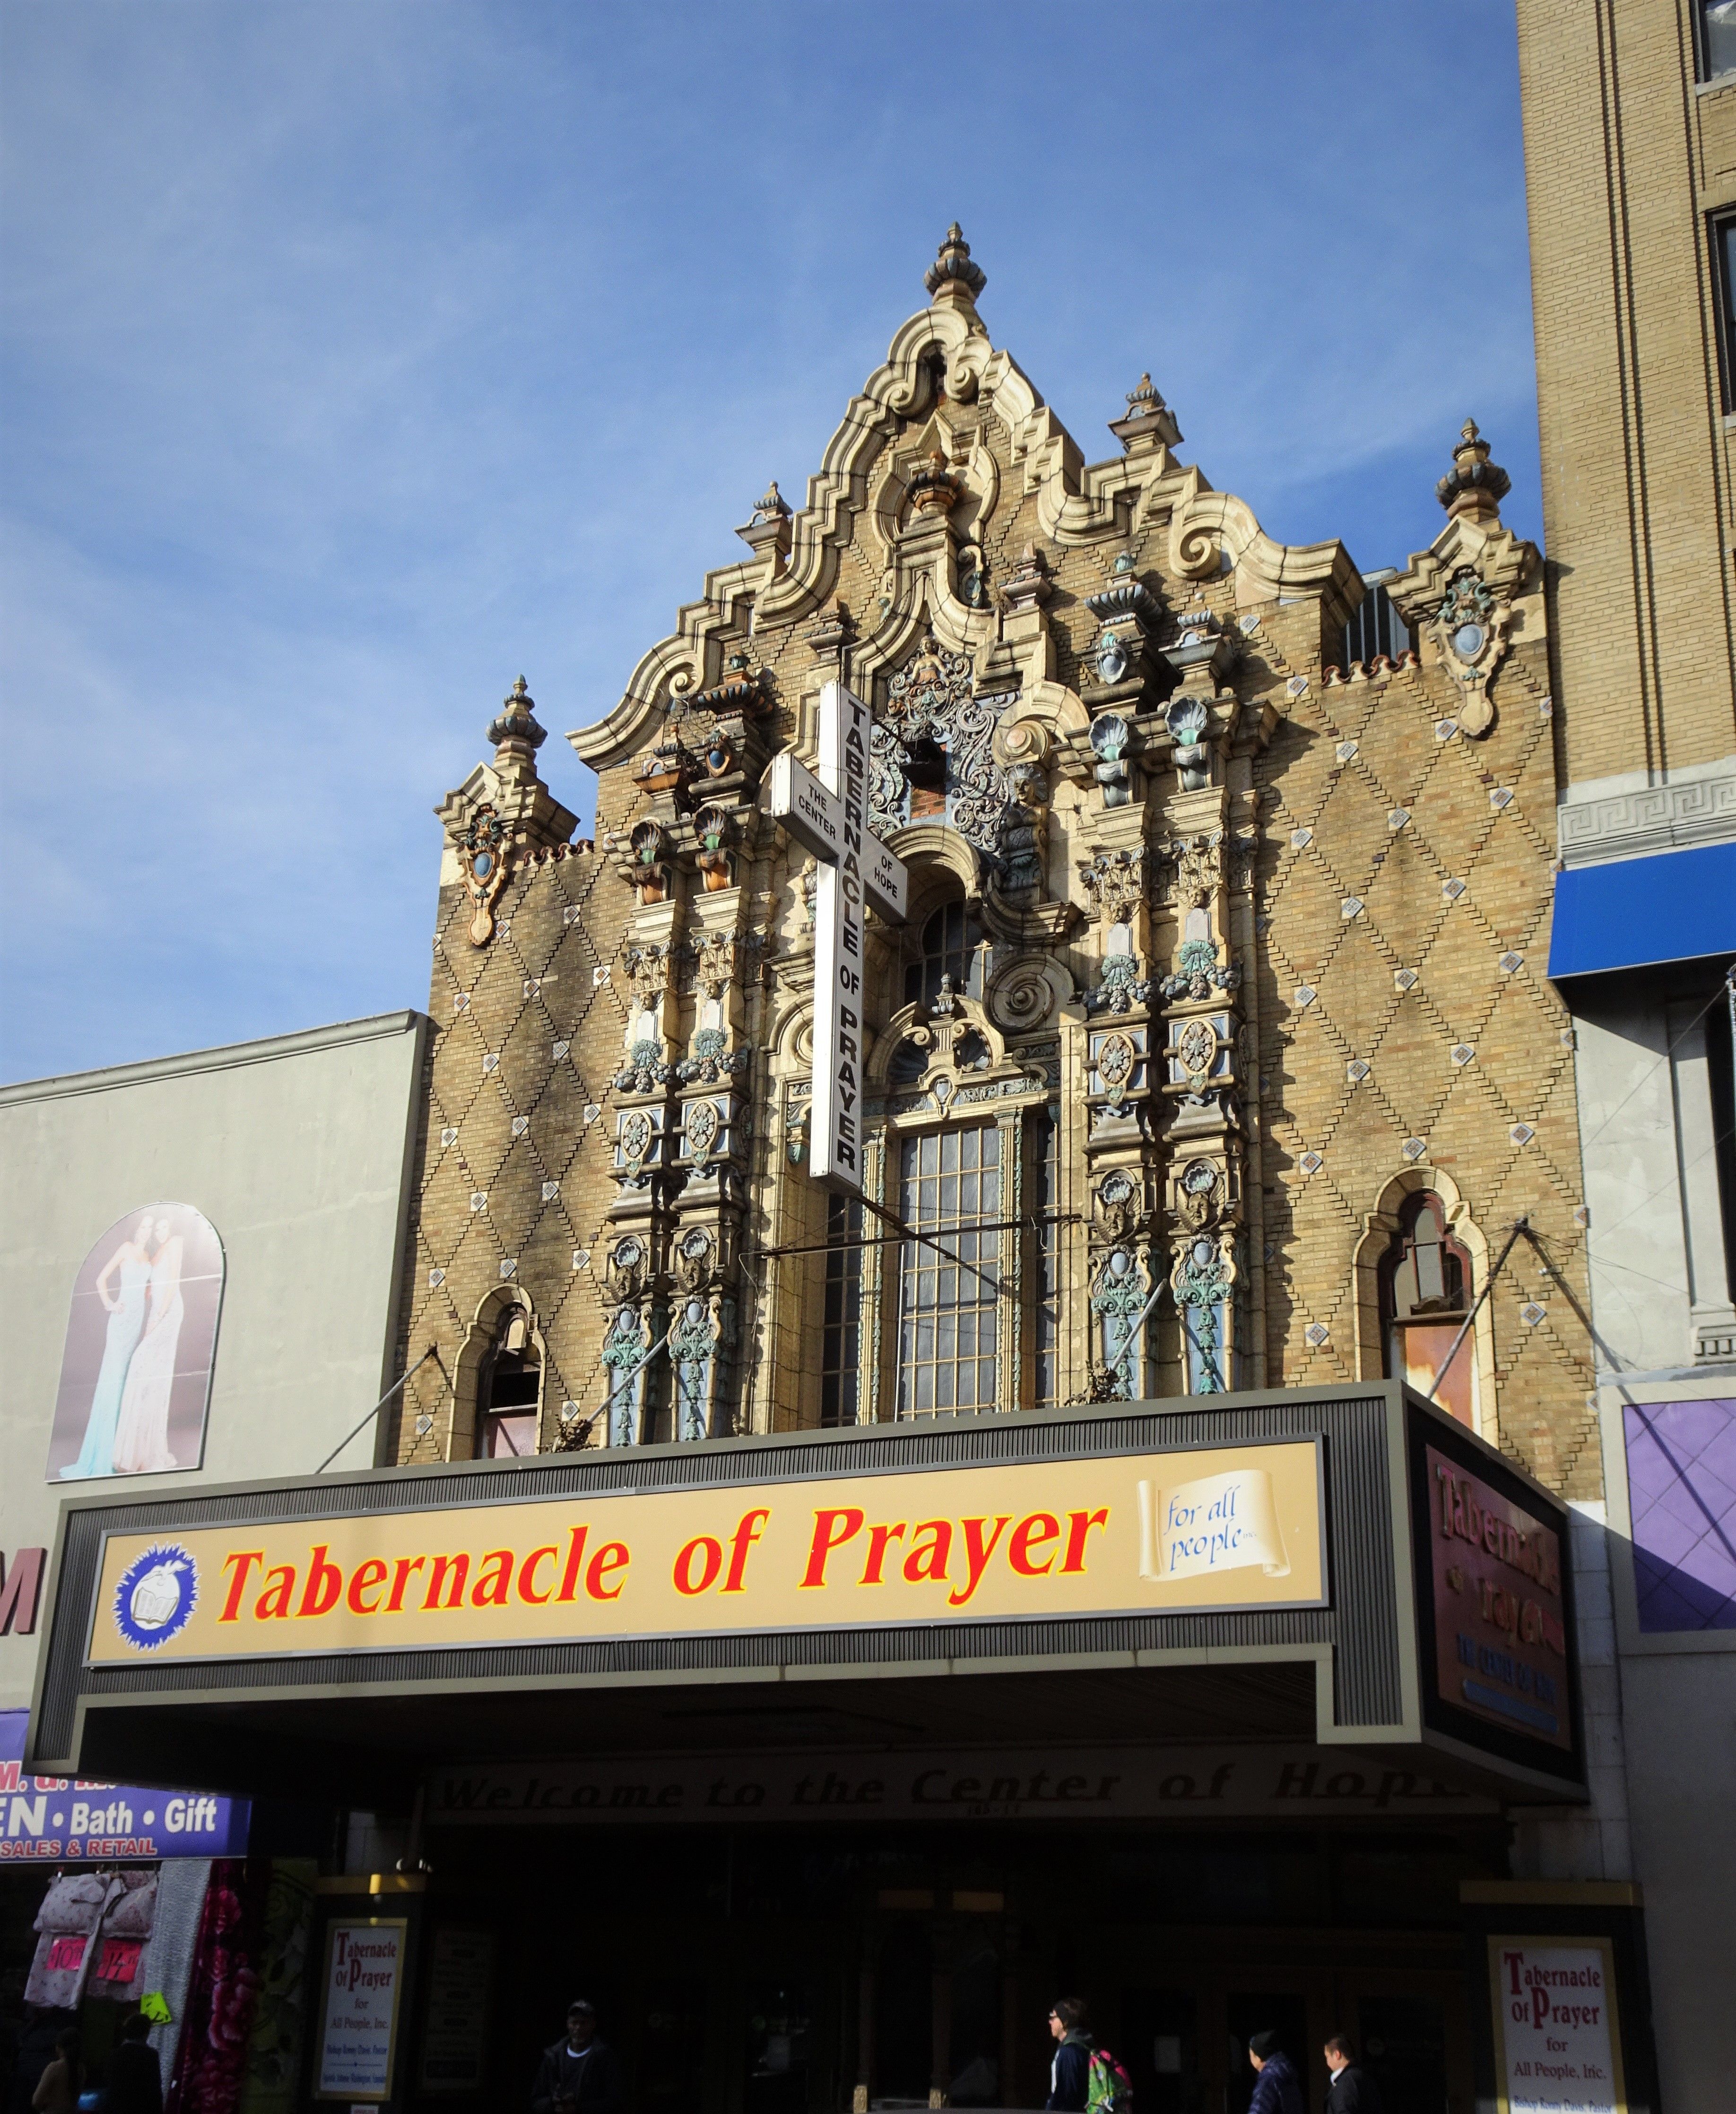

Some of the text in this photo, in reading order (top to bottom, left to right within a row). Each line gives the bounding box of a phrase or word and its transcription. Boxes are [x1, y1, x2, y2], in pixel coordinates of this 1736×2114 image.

[799, 794, 836, 840] CENTER
[808, 783, 827, 811] THE
[875, 867, 897, 899] HOPE
[881, 854, 893, 873] OF
[837, 699, 866, 1172] TABERNACLE OF PRAYER
[1163, 1485, 1241, 1535] for all
[217, 1505, 1111, 1624] Tabernacle of Prayer
[1170, 1518, 1243, 1572] people
[436, 1776, 684, 1811] Welcome
[704, 1775, 766, 1808] to
[790, 1771, 886, 1806] the
[911, 1768, 1121, 1803] Center
[1159, 1763, 1235, 1799] of
[0, 1796, 217, 1837] N Bath Gift
[66, 1839, 81, 1857] &
[87, 1837, 158, 1857] RETAIL
[337, 1932, 397, 1966] Tabernacle
[348, 1958, 392, 1992] Prayer
[1503, 1952, 1600, 1995] Tabernacle
[1531, 1987, 1599, 2029] Prayer
[1546, 2036, 1568, 2052] for
[1514, 2061, 1531, 2076] All
[1583, 2064, 1607, 2079] Inc.
